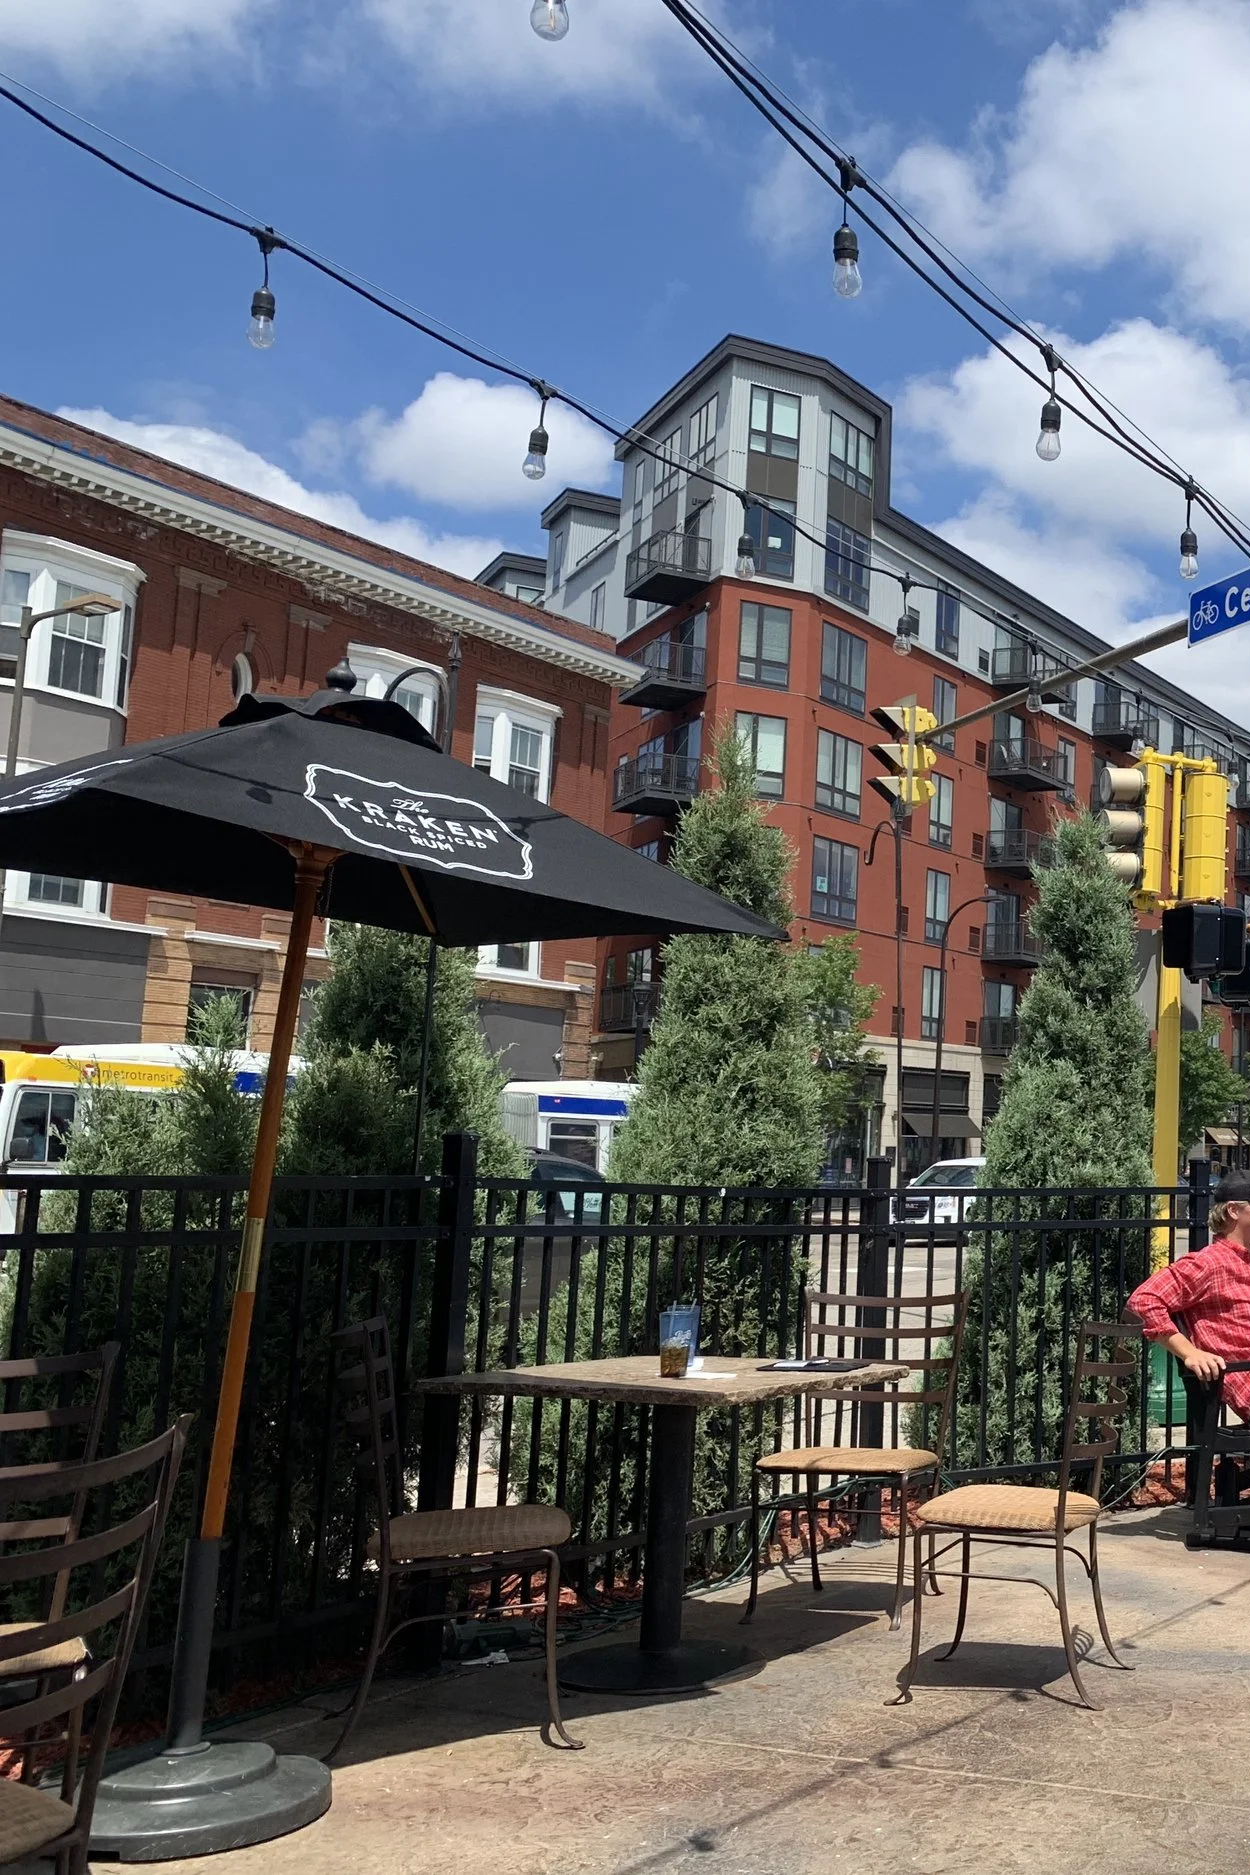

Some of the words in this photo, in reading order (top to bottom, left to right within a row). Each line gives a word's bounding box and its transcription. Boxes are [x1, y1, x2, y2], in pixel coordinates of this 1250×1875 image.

[332, 793, 499, 843] KRAKEN
[390, 799, 430, 814] The
[361, 815, 420, 836] BLACK
[427, 831, 488, 849] SPICED
[410, 835, 455, 852] RUM
